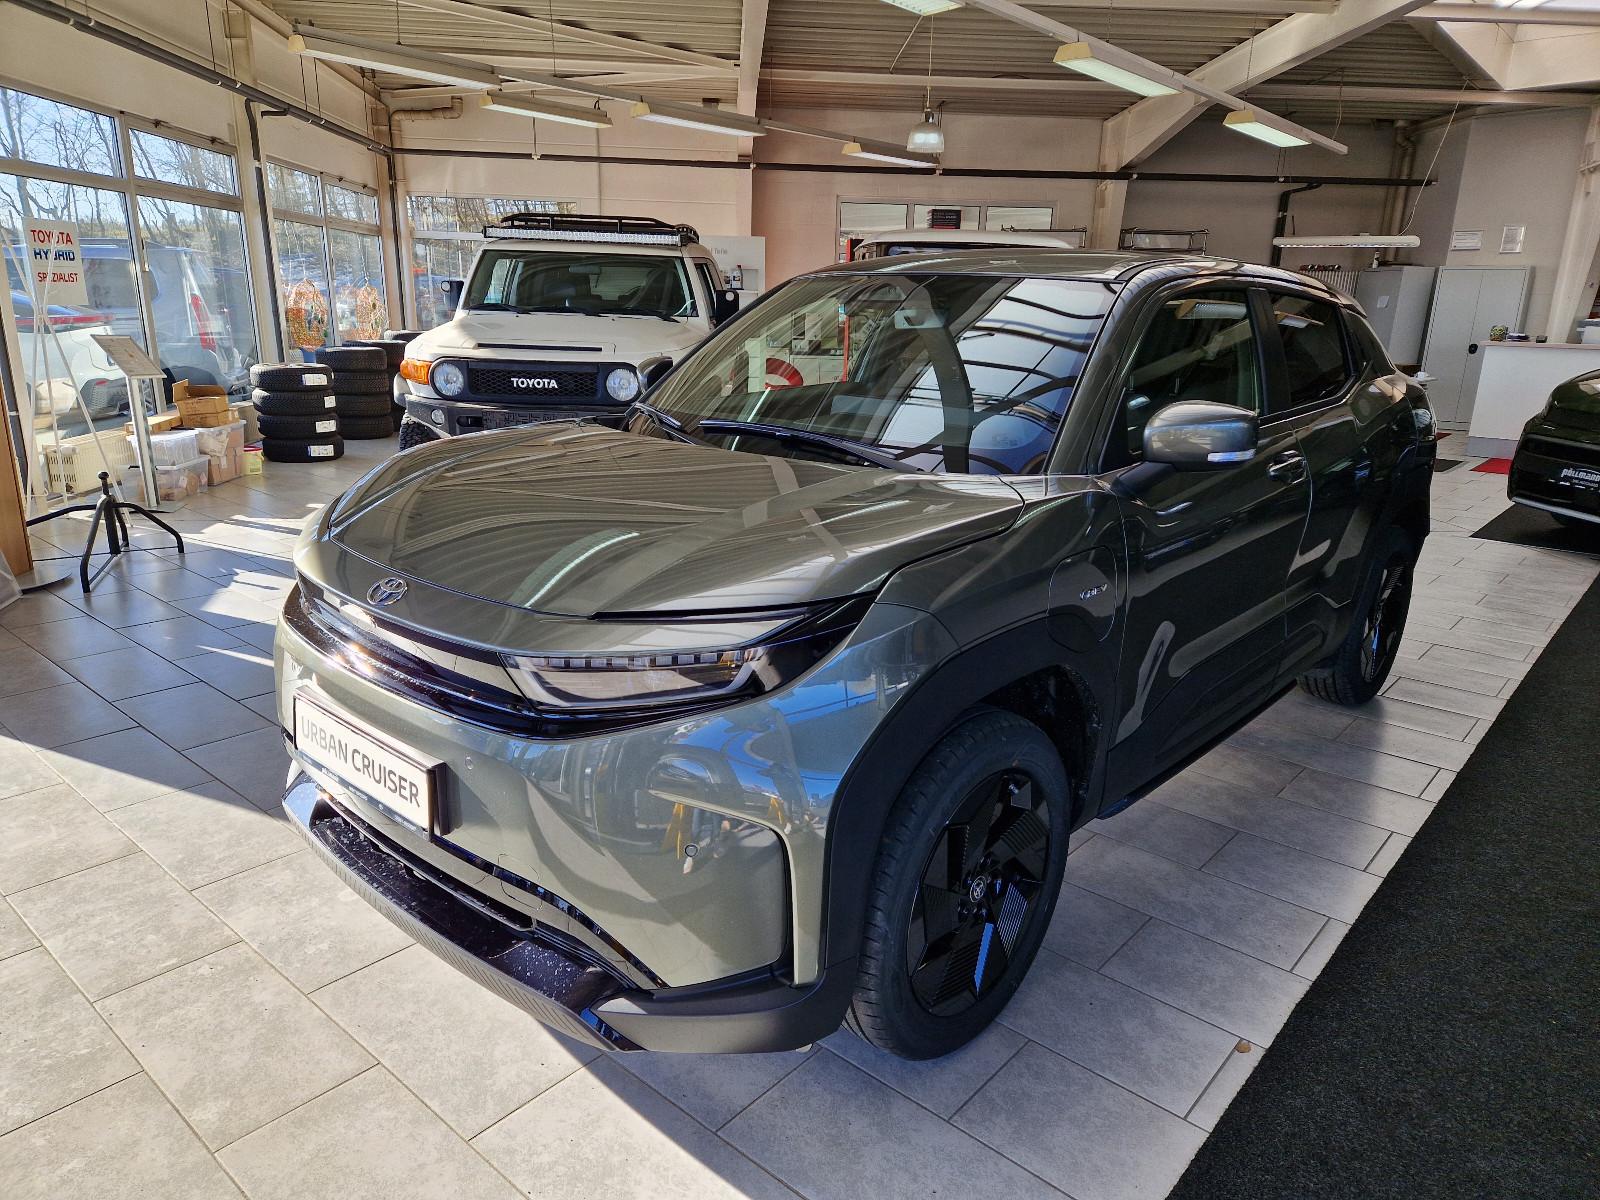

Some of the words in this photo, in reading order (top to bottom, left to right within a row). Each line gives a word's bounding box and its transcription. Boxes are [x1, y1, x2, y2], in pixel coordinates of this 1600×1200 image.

[37, 272, 78, 282] SPZIALIST
[511, 377, 558, 388] TOYOTA
[301, 716, 348, 763] URBAN
[352, 749, 421, 808] CRUISER
